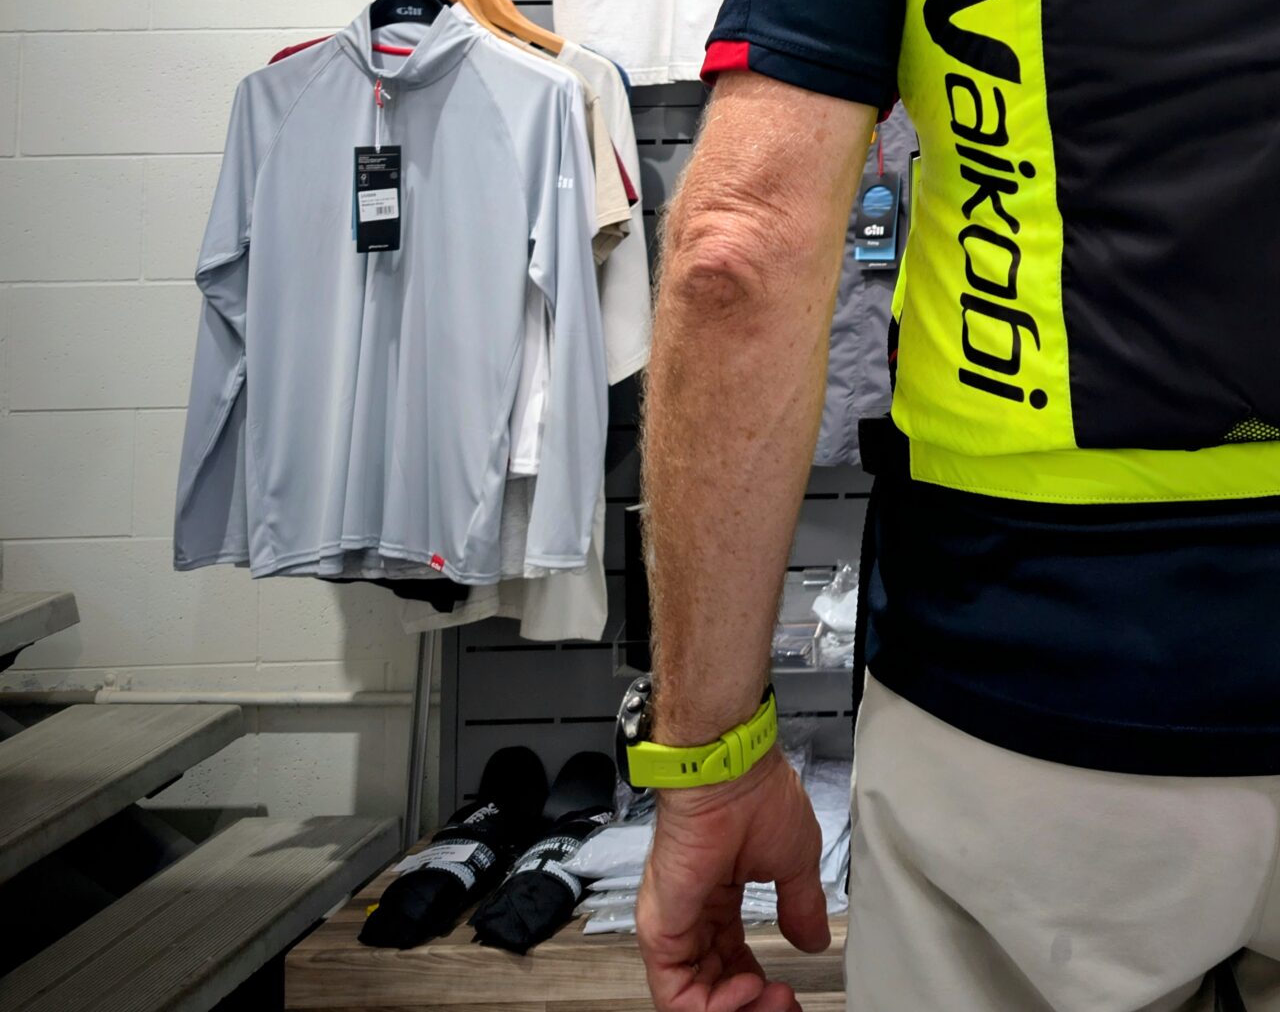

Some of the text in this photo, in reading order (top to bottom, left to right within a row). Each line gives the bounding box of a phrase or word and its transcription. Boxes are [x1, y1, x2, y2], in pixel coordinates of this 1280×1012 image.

[396, 6, 422, 16] Gill
[558, 175, 574, 189] ill
[864, 224, 885, 236] Gill
